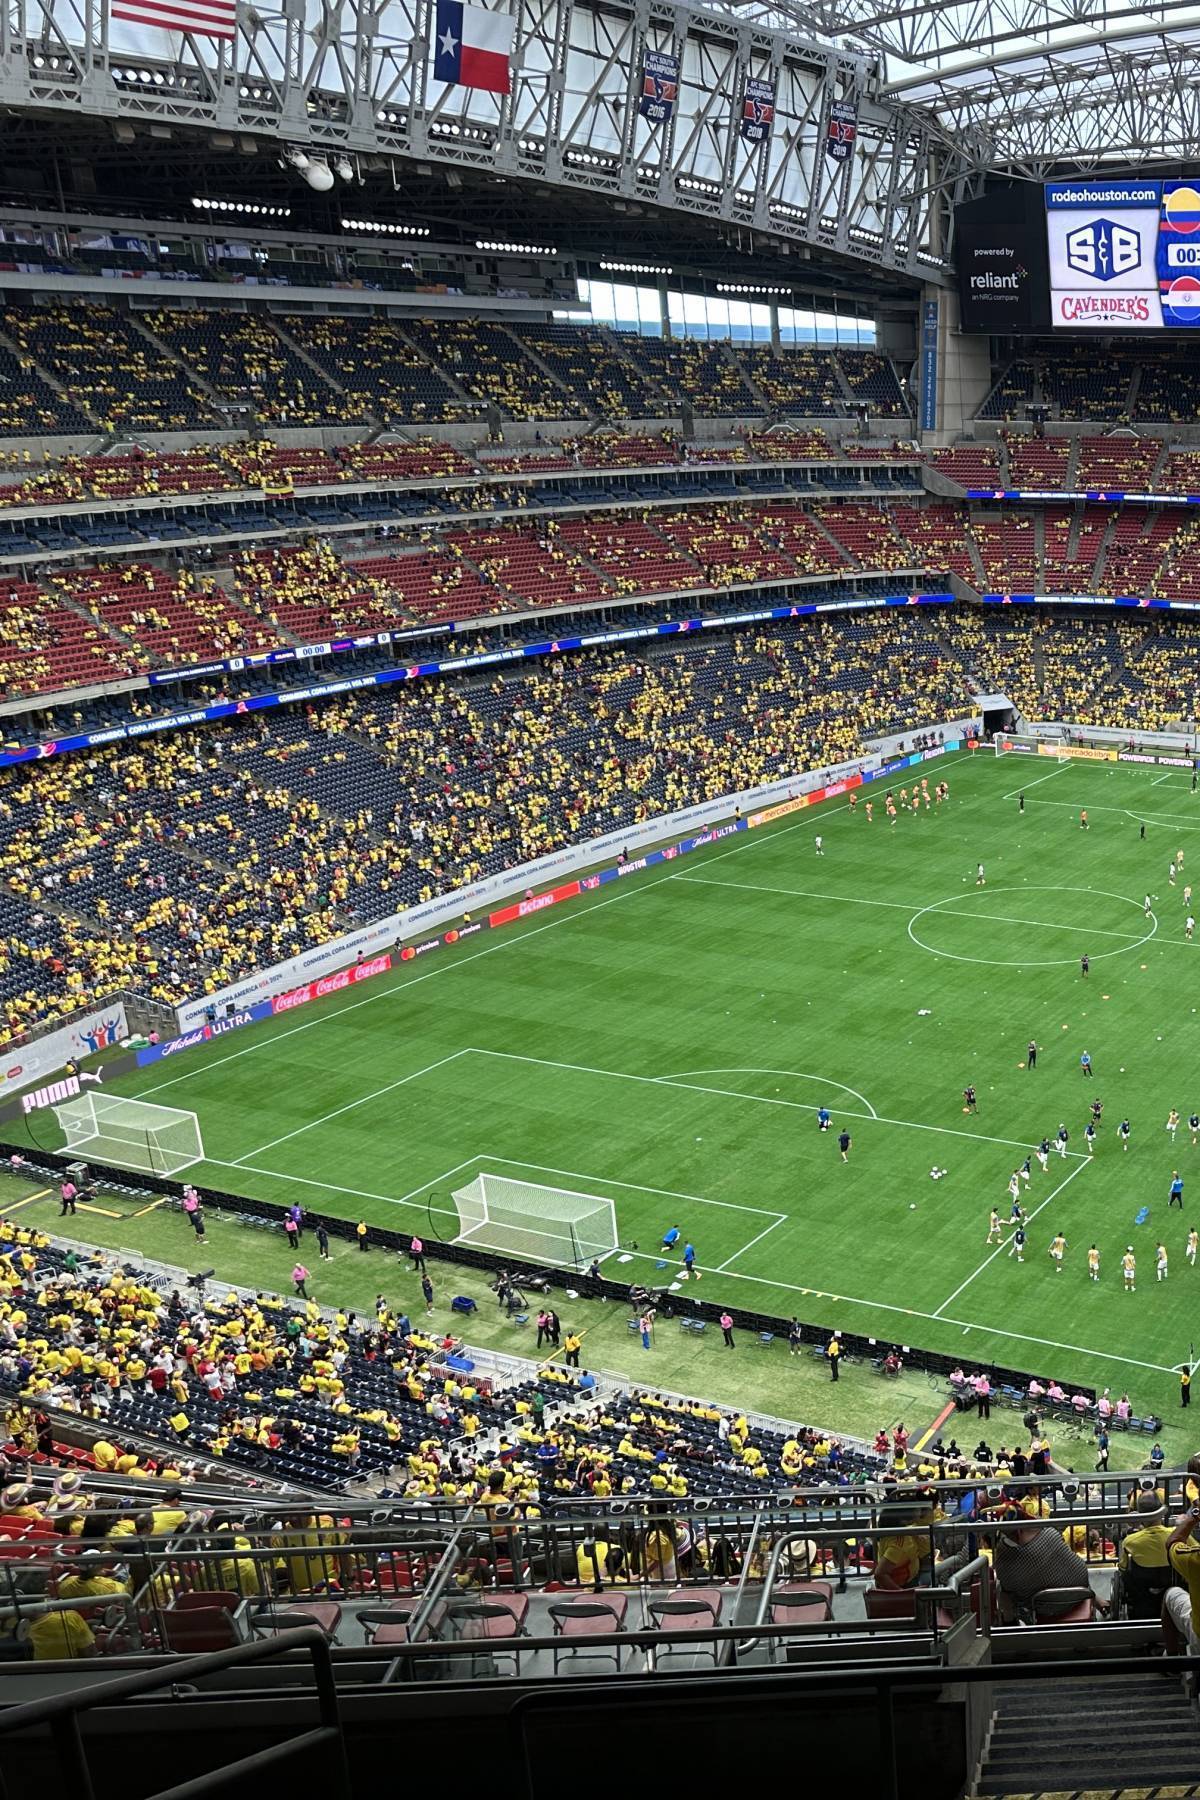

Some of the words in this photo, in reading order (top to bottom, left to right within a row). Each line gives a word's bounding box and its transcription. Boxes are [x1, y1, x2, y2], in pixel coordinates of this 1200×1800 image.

[646, 61, 677, 77] CHAMPIONS
[747, 86, 773, 99] CHAMPIONS
[647, 104, 665, 118] 2016
[833, 107, 855, 120] CHAMPIONS
[833, 144, 846, 156] 2019
[1051, 189, 1156, 203] rodeohouston.com
[974, 247, 1000, 257] powered
[1002, 248, 1014, 258] by
[1069, 227, 1140, 276] S&B
[970, 273, 1019, 289] reliant
[994, 295, 1019, 303] company
[1061, 296, 1150, 321] CAVENDER'S
[303, 645, 325, 655] 0000
[147, 718, 177, 732] AMERICA
[1059, 747, 1093, 758] mercado
[1094, 749, 1111, 759] libre
[1118, 753, 1156, 764] POWERADE
[1158, 757, 1194, 767] POWERAD
[716, 824, 738, 838] ULTRA
[617, 858, 647, 876] HOUSTON
[518, 894, 554, 917] Betano
[303, 951, 332, 968] CONMEBOL
[332, 944, 346, 955] COPA
[346, 936, 368, 949] AMERICA
[218, 995, 233, 1006] COPA
[232, 985, 258, 1001] AMERICA
[259, 981, 270, 989] USA
[270, 974, 283, 984] 2024
[275, 987, 310, 1012] Coca-Cola
[162, 1031, 203, 1056] Michelob
[212, 1012, 253, 1035] ULTRA
[22, 1076, 81, 1114] PUMA
